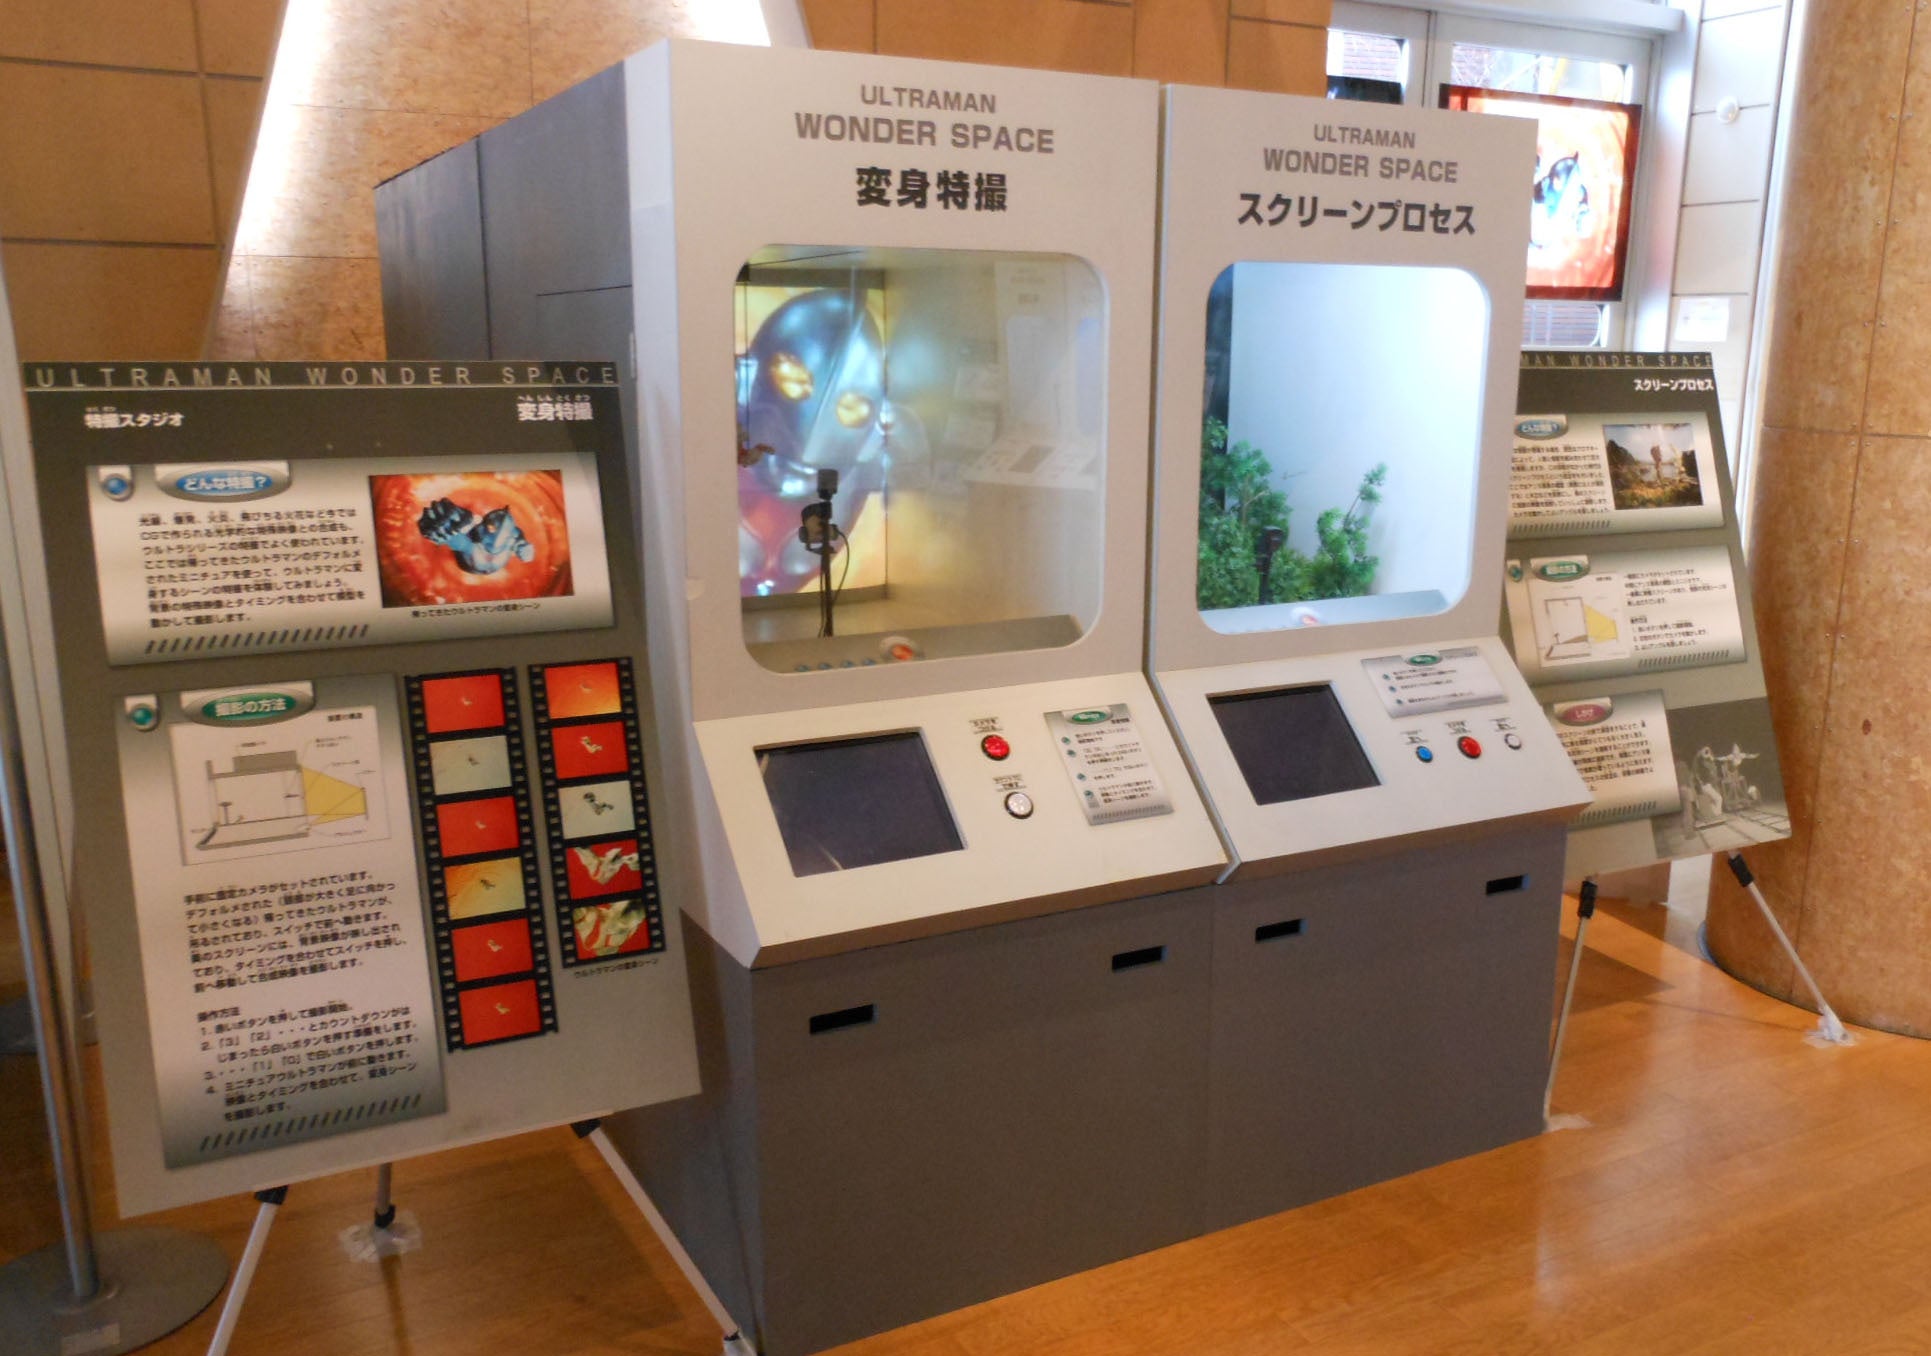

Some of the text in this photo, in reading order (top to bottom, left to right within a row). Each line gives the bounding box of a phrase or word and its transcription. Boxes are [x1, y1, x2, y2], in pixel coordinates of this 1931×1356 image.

[860, 84, 998, 114] ULTRAMAN
[795, 112, 1054, 155] WONDER SPACE
[1314, 124, 1416, 150] ULTRAMAN
[1263, 147, 1459, 184] WONDER SPACE
[855, 166, 1010, 213] 変身特撮
[1238, 192, 1477, 237] スクリーンプロセス
[1569, 354, 1645, 367] WONDER
[1658, 354, 1713, 367] SPACE
[35, 365, 617, 389] ULTRAMAN WONDER SPACE
[1634, 378, 1715, 391] スクリーンプロセス
[84, 411, 185, 429] 特撮スタジオ
[517, 402, 594, 421] 変身特撮
